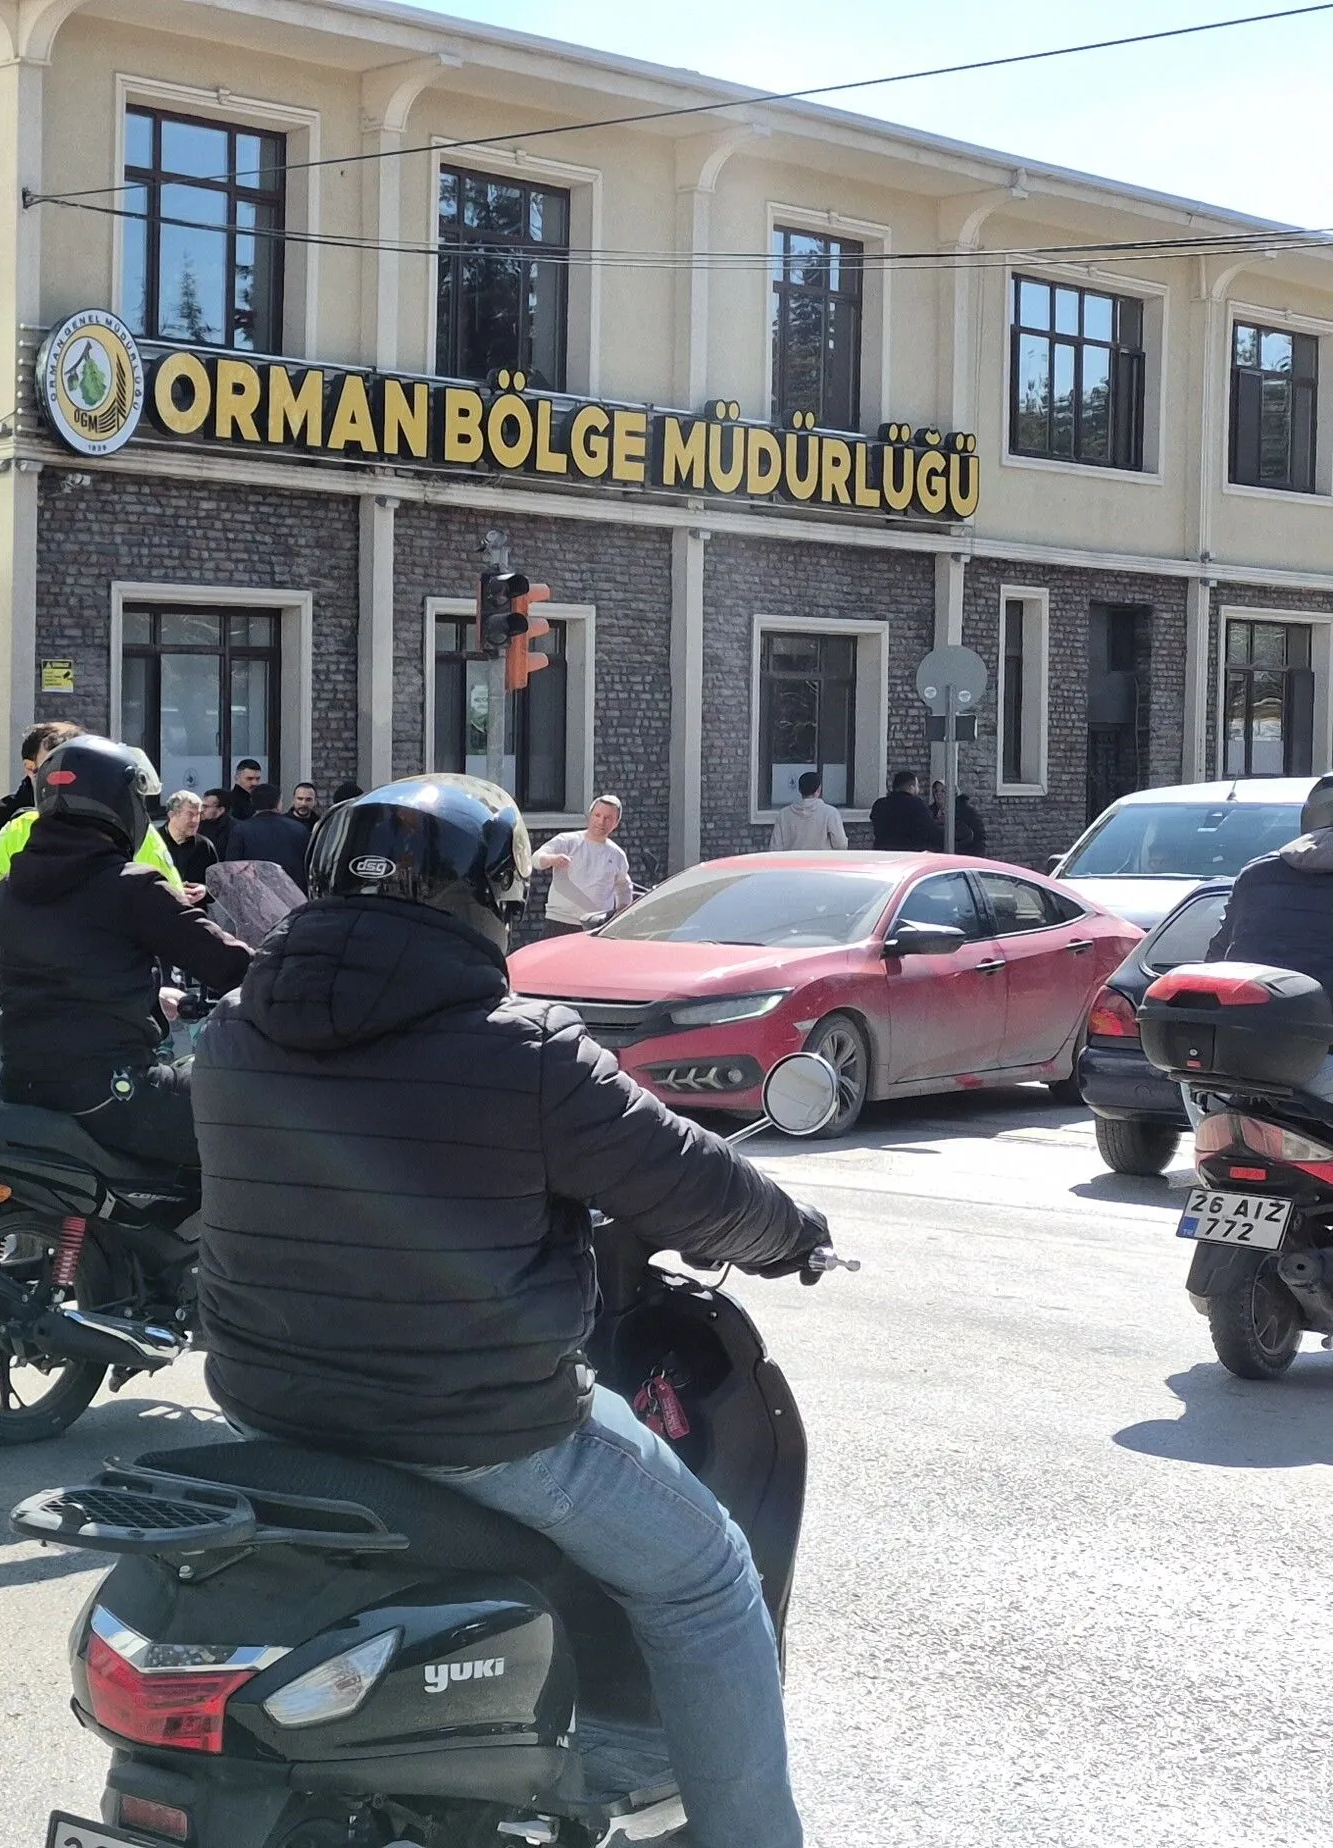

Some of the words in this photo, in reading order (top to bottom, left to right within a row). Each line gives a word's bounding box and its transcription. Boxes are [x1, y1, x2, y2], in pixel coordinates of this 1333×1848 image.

[74, 409, 99, 434] OGM
[154, 352, 429, 459] ORMAN
[444, 368, 648, 482] BÖLGE
[662, 399, 980, 518] MÜDÜRLÜĞÜ
[1190, 1194, 1225, 1214] 26
[1204, 1217, 1255, 1242] 772
